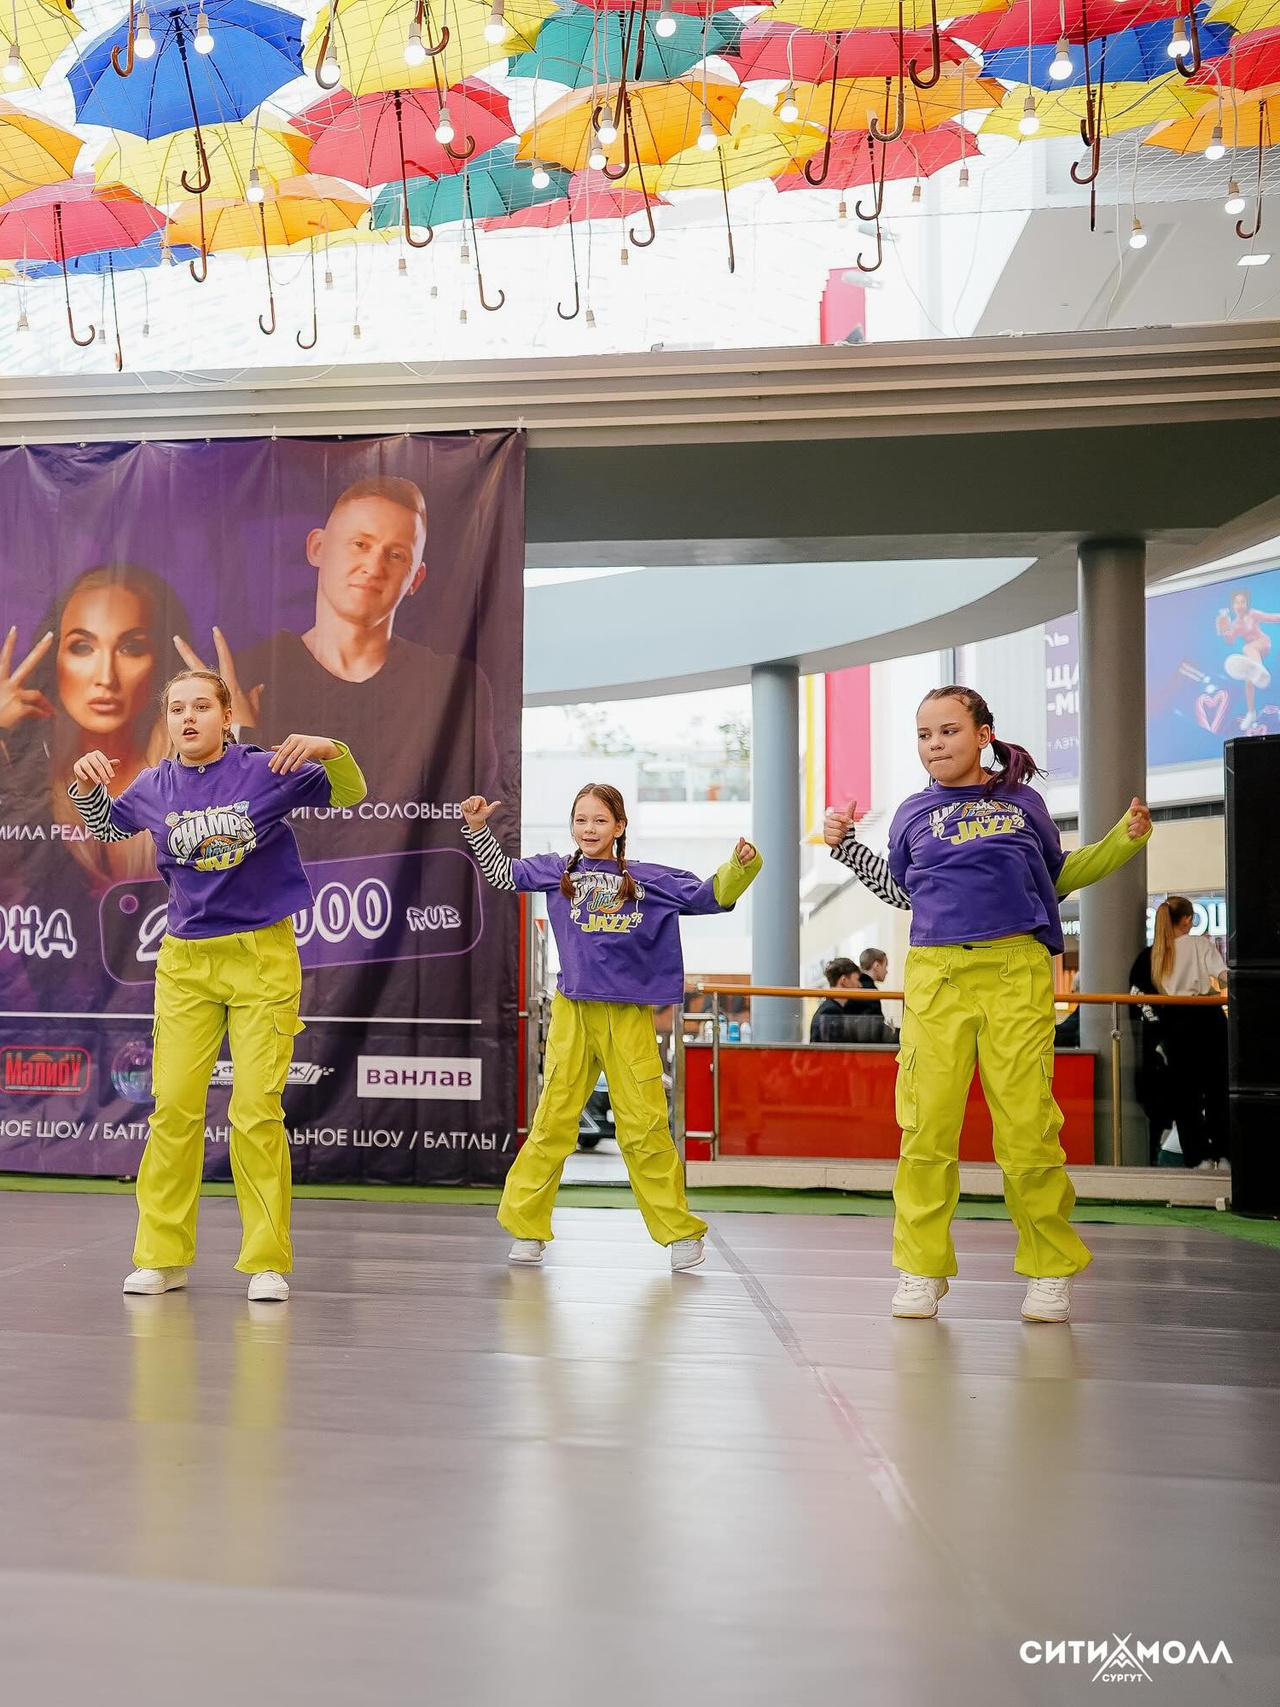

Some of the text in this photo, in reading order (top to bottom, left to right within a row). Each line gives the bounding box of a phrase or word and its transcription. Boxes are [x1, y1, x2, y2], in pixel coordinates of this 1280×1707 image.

[359, 802, 462, 820] СОЛОВЬЕВ
[170, 813, 257, 859] CHAMPS
[951, 819, 1016, 845] JAZZ
[406, 904, 462, 932] RUB
[581, 914, 631, 933] JAZZ
[366, 1068, 473, 1087] ванлав
[36, 1119, 84, 1139] ШОУ
[103, 1122, 151, 1140] БАТТ
[353, 1130, 403, 1148] ШОУ
[424, 1132, 496, 1151] БАТТЛЫ
